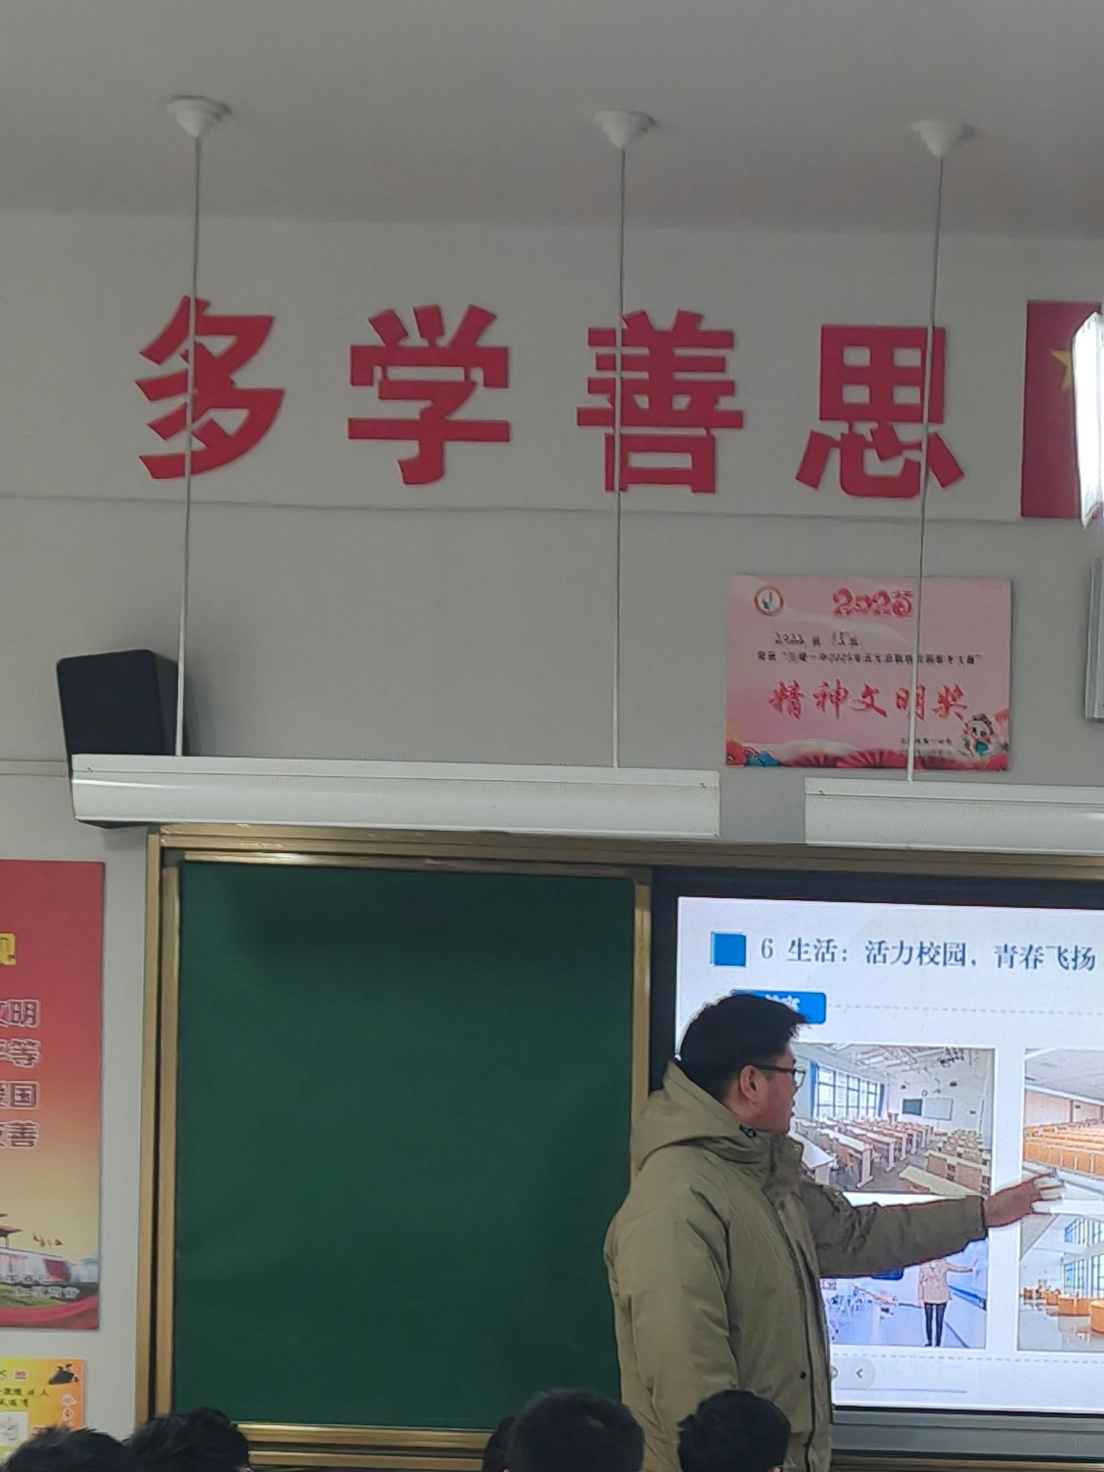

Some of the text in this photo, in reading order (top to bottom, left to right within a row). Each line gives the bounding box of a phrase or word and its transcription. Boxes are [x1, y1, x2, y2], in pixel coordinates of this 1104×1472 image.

[135, 297, 965, 499] 多学善思
[769, 678, 969, 720] 精神文明奖
[760, 938, 774, 960] 6
